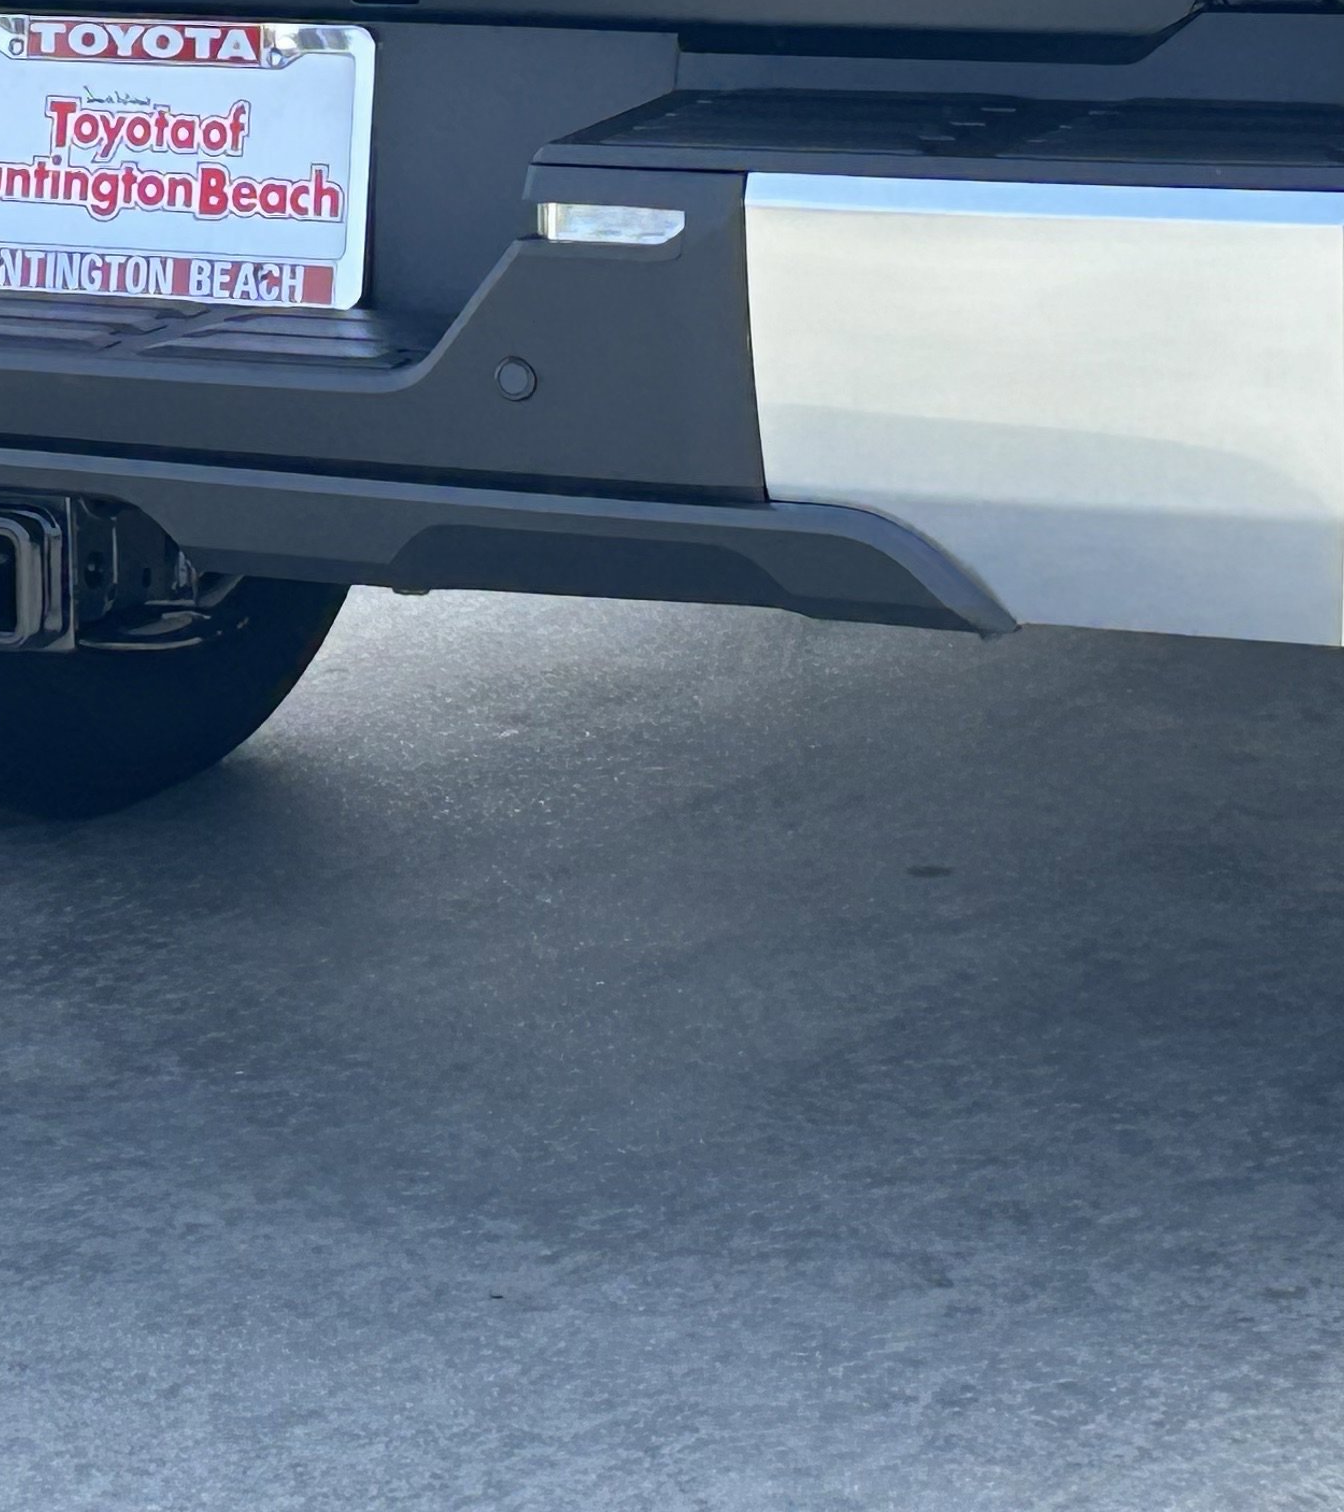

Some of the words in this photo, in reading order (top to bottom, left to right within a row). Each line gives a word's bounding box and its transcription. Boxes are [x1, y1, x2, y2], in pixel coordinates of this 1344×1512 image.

[30, 22, 258, 61] TOYOTA
[49, 101, 196, 158] Toyota
[201, 103, 247, 151] of
[198, 166, 340, 218] Beach
[189, 260, 304, 305] BEACH
